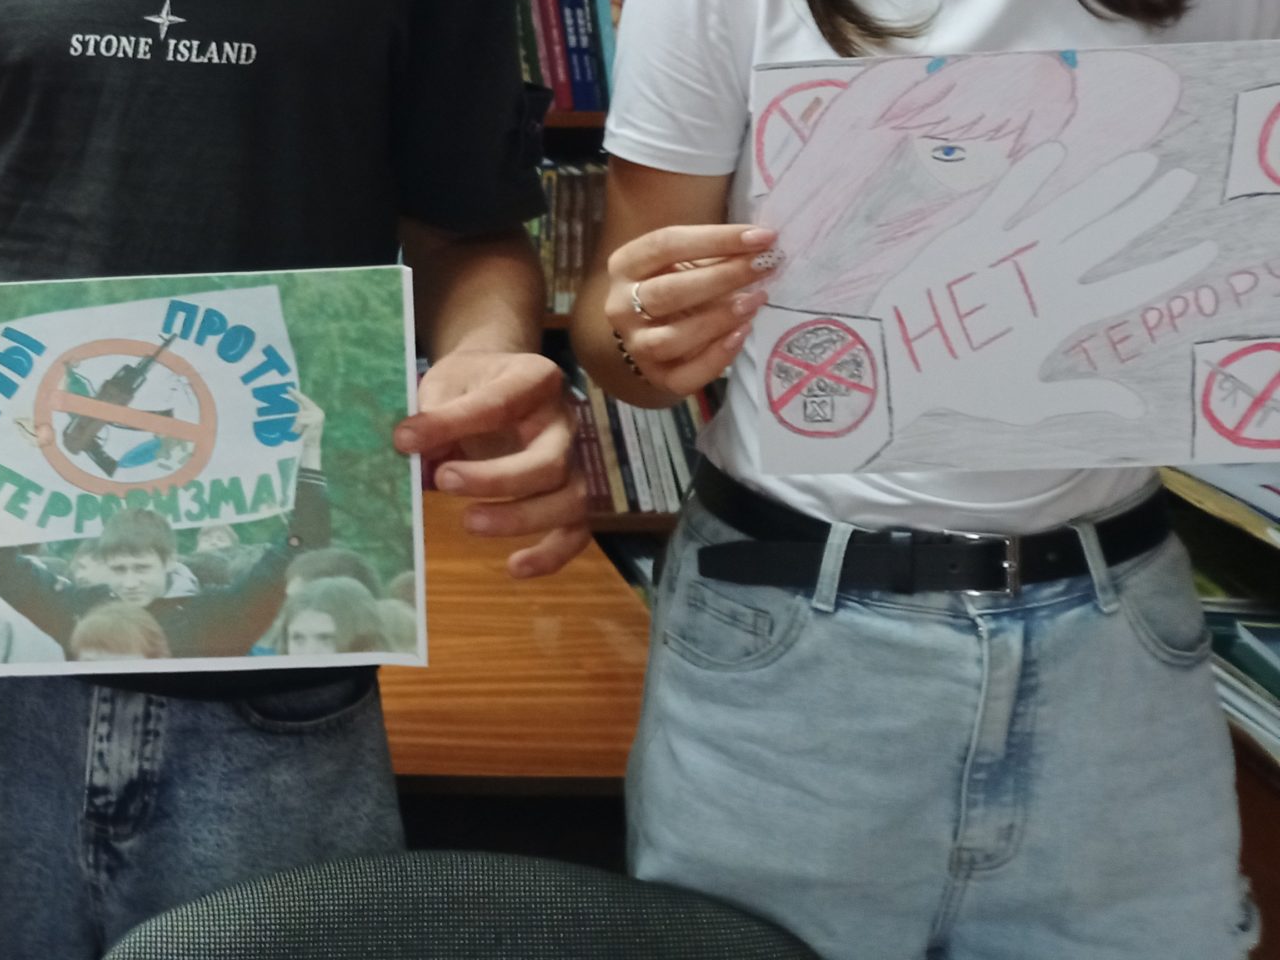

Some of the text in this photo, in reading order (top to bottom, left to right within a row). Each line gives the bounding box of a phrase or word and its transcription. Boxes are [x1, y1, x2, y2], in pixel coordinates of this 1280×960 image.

[70, 34, 257, 65] STONE ISLAND
[892, 241, 1039, 373] НЕТ
[162, 300, 303, 447] ПРОТИВ
